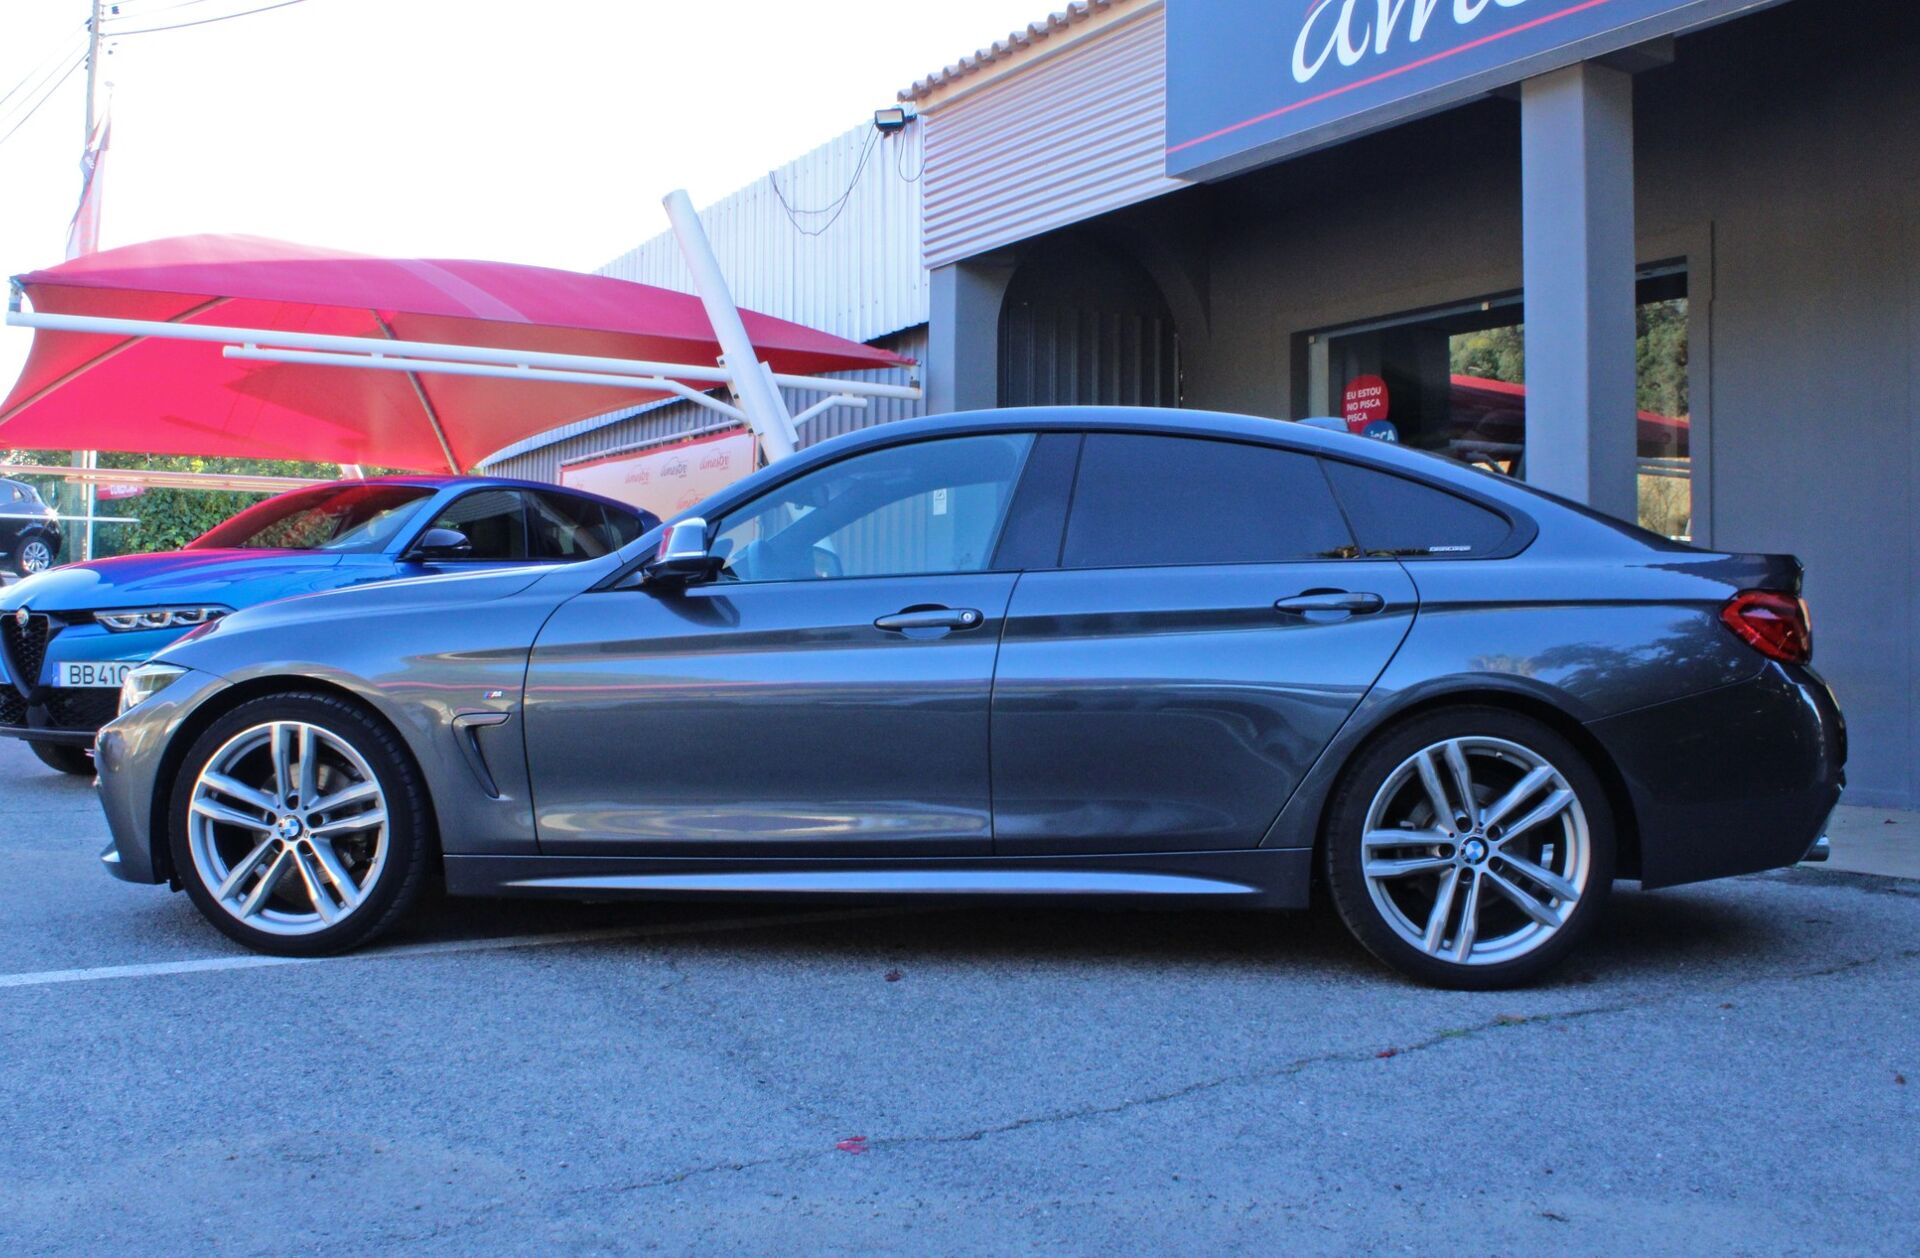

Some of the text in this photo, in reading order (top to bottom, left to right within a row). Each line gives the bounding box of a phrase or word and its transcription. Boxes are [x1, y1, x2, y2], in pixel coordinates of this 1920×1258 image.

[1291, 0, 1526, 84] am
[1346, 387, 1382, 400] EU ESTOU
[1346, 399, 1381, 411] NO PISCA
[1347, 412, 1368, 422] PISCA
[70, 665, 95, 685] BB
